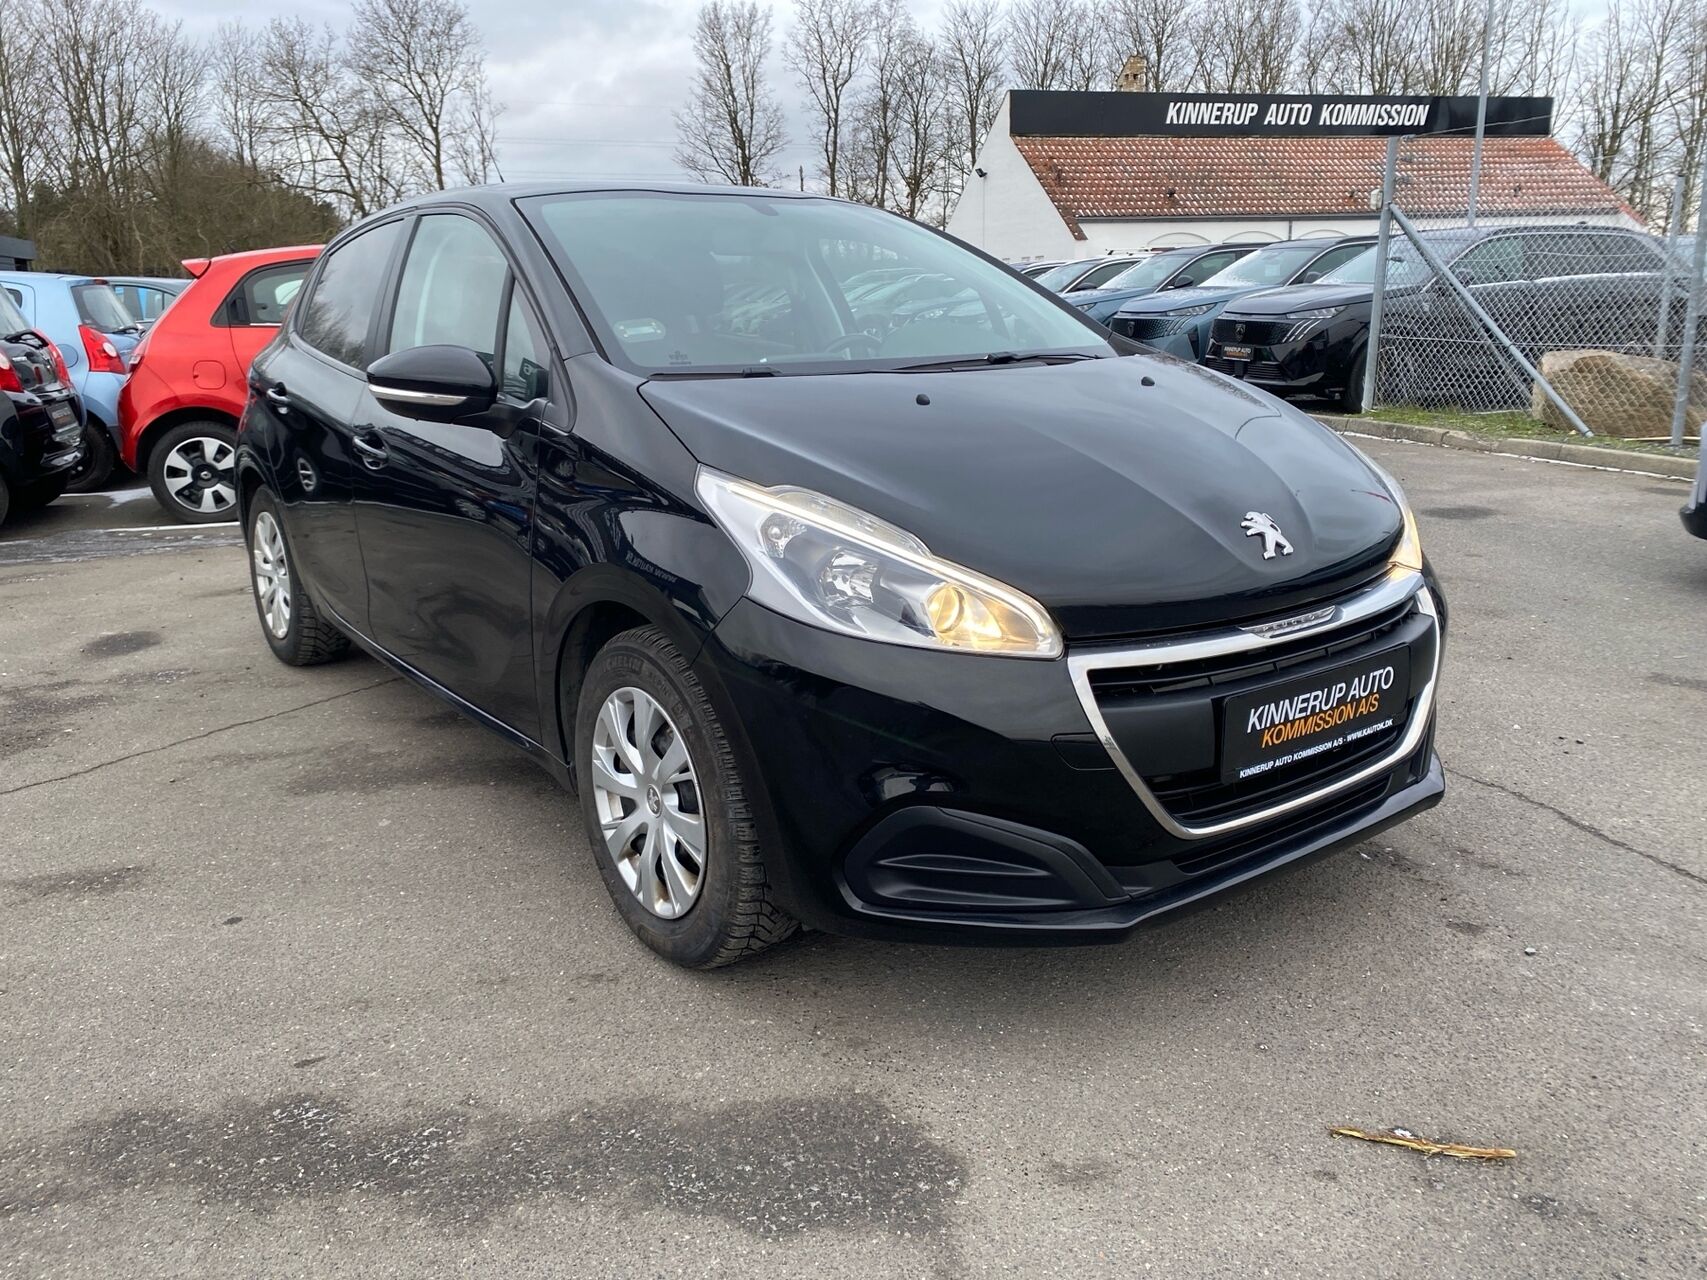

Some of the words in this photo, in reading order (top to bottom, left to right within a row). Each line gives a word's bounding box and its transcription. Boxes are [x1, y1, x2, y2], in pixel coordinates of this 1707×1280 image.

[1165, 102, 1258, 125] KINNERUP
[1264, 103, 1313, 126] AUTO
[1319, 104, 1430, 126] KOMMISSION
[1263, 612, 1323, 633] PEUGEO
[1247, 683, 1346, 733] KINNERUP
[1347, 666, 1394, 702] AUTO
[1262, 702, 1356, 748] KOMMISSION
[1356, 694, 1379, 717] A/S
[1239, 761, 1274, 778] KINNERUP
[1274, 755, 1293, 767] AUTO
[1293, 741, 1332, 760] KOMMISSION
[1332, 737, 1343, 748] A/S
